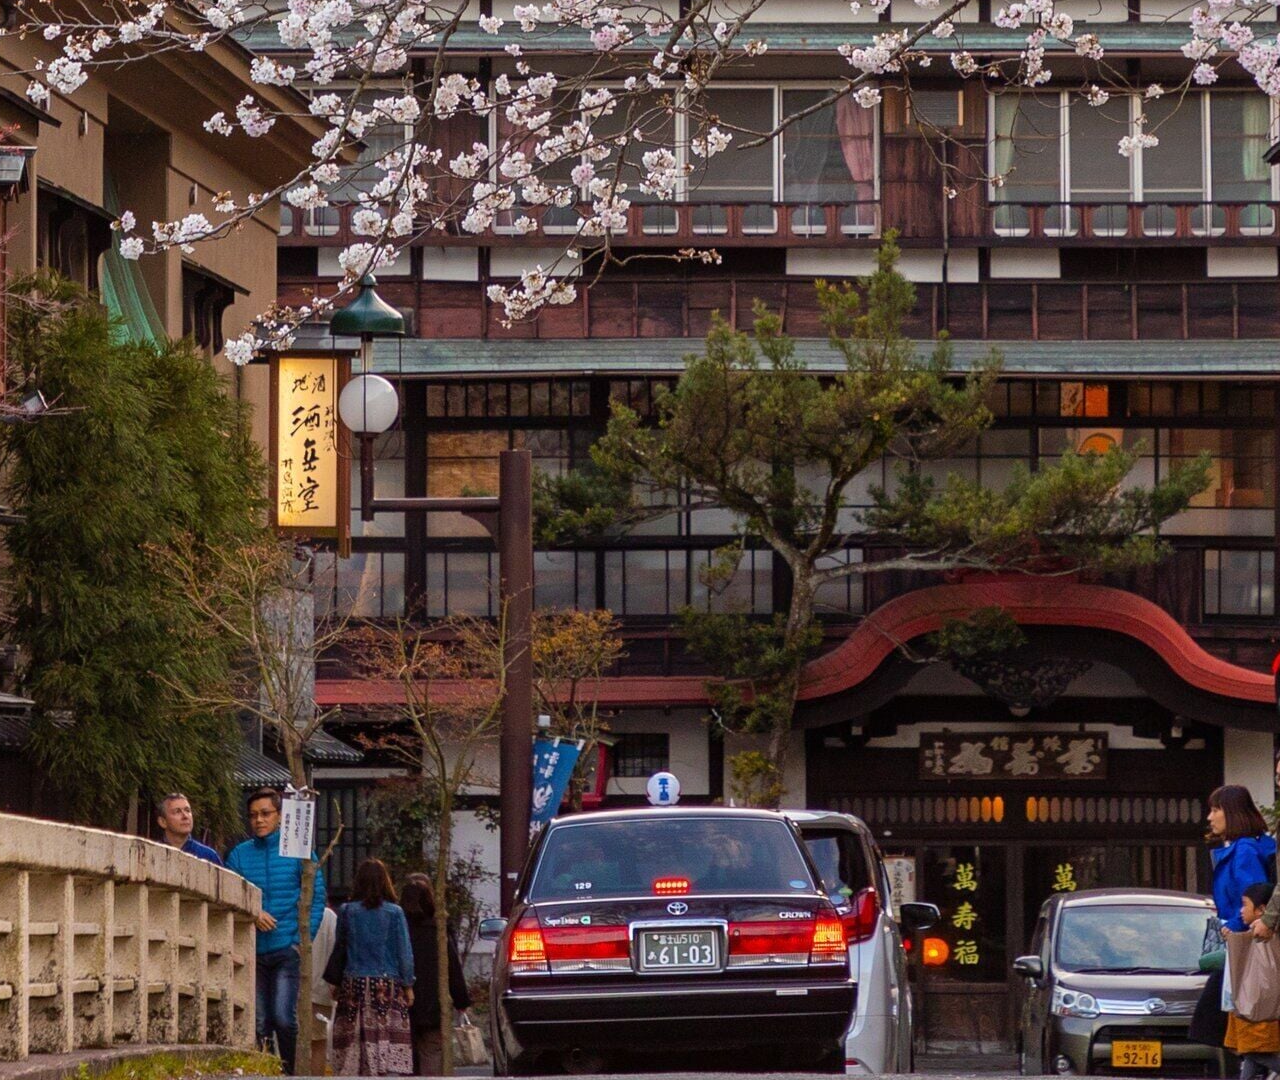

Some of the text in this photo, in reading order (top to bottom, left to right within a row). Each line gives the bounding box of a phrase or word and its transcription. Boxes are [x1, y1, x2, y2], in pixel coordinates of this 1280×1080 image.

[575, 882, 592, 890] 129
[779, 911, 811, 919] CROWN
[952, 863, 980, 965] 萬寿福
[659, 945, 712, 965] 61-03
[1124, 1052, 1158, 1065] 92-16
